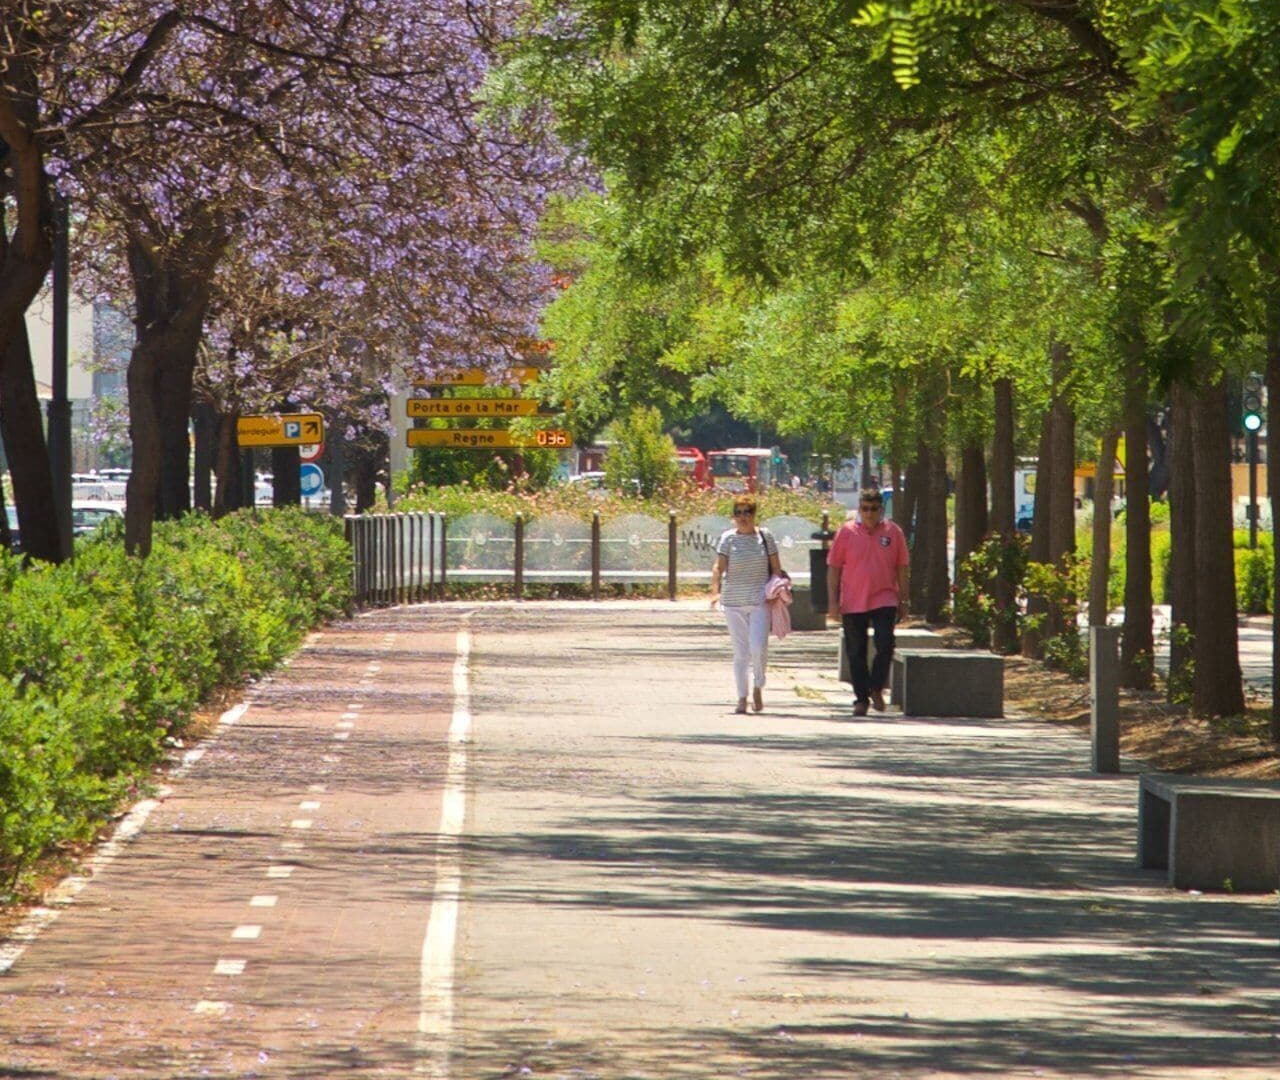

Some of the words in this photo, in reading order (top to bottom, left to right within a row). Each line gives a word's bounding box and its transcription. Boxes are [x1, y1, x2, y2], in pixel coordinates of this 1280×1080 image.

[413, 402, 449, 413] Porta
[455, 402, 472, 413] de
[477, 402, 489, 413] la
[495, 402, 520, 413] Mar
[453, 433, 495, 445] Regne
